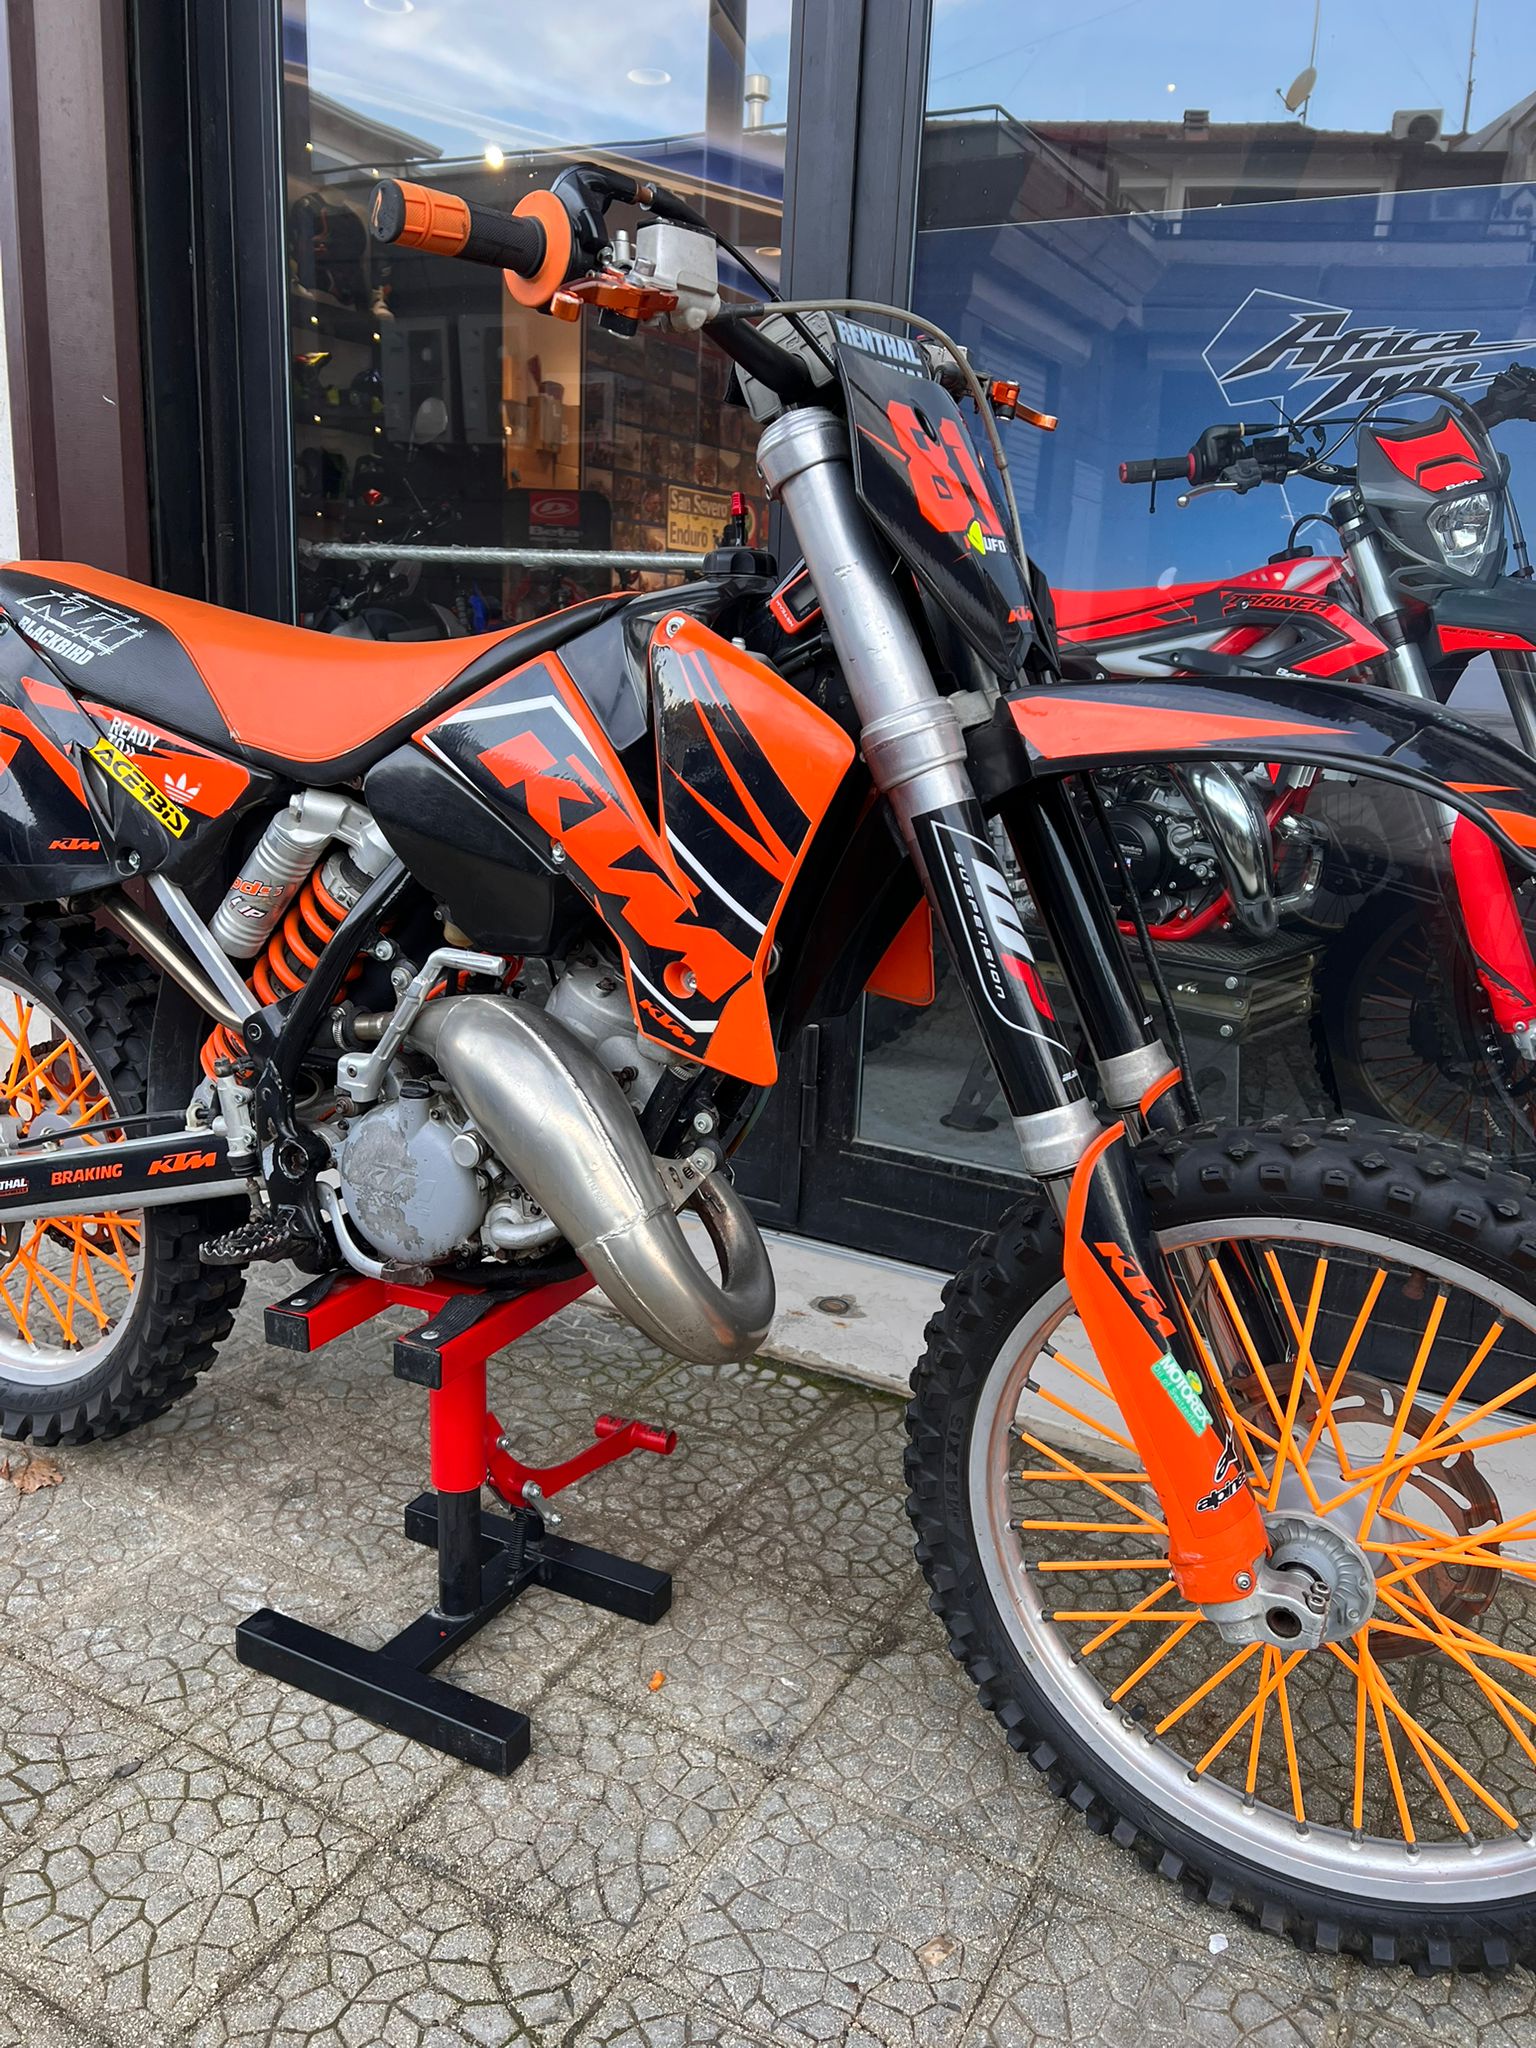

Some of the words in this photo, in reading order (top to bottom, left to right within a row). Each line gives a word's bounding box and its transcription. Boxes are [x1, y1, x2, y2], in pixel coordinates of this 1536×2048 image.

[836, 319, 922, 365] RENTHAL
[1219, 311, 1536, 388] Africa
[1294, 357, 1498, 425] Twin
[887, 400, 1005, 535] 81
[670, 491, 691, 512] San
[693, 493, 728, 517] Severo
[529, 525, 579, 538] Beta
[669, 521, 708, 547] Enduro
[983, 536, 1007, 553] UFO
[1230, 594, 1333, 612] TRAINER
[18, 616, 96, 666] BLACKBIRD
[109, 716, 161, 752] READY
[48, 837, 100, 850] KTM
[477, 730, 753, 1003] KTM
[638, 998, 696, 1047] KTM
[51, 1163, 123, 1186] BRAKING
[148, 1151, 217, 1176] KTM
[1094, 1242, 1178, 1338] KTM
[1158, 1354, 1209, 1429] MOTOREX
